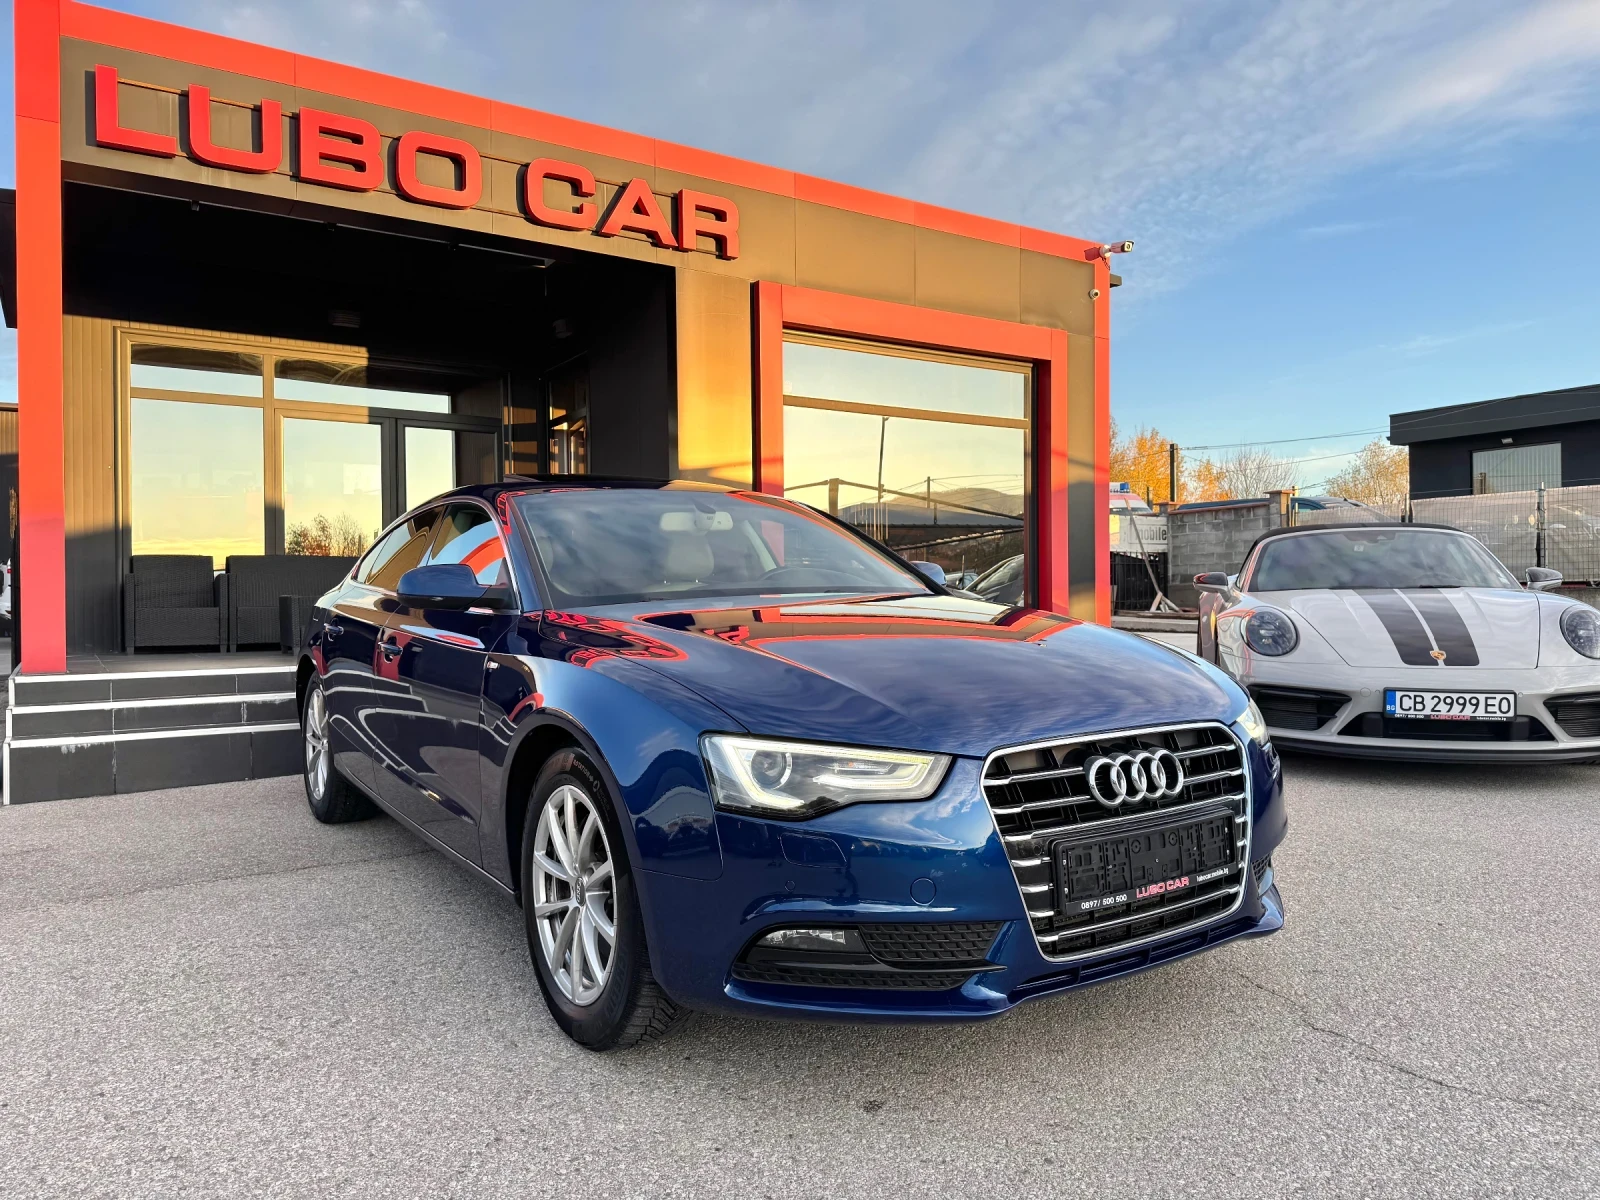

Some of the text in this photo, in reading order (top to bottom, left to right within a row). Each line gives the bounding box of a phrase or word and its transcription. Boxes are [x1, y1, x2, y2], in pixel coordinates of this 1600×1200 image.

[93, 64, 740, 260] LUBO CAR
[1399, 694, 1426, 712] CB
[1430, 695, 1480, 714] 2999
[1081, 898, 1101, 909] 0897/
[1102, 896, 1115, 906] 500
[1115, 894, 1127, 903] 500
[1136, 882, 1166, 898] LUBO
[1166, 876, 1190, 891] CAR
